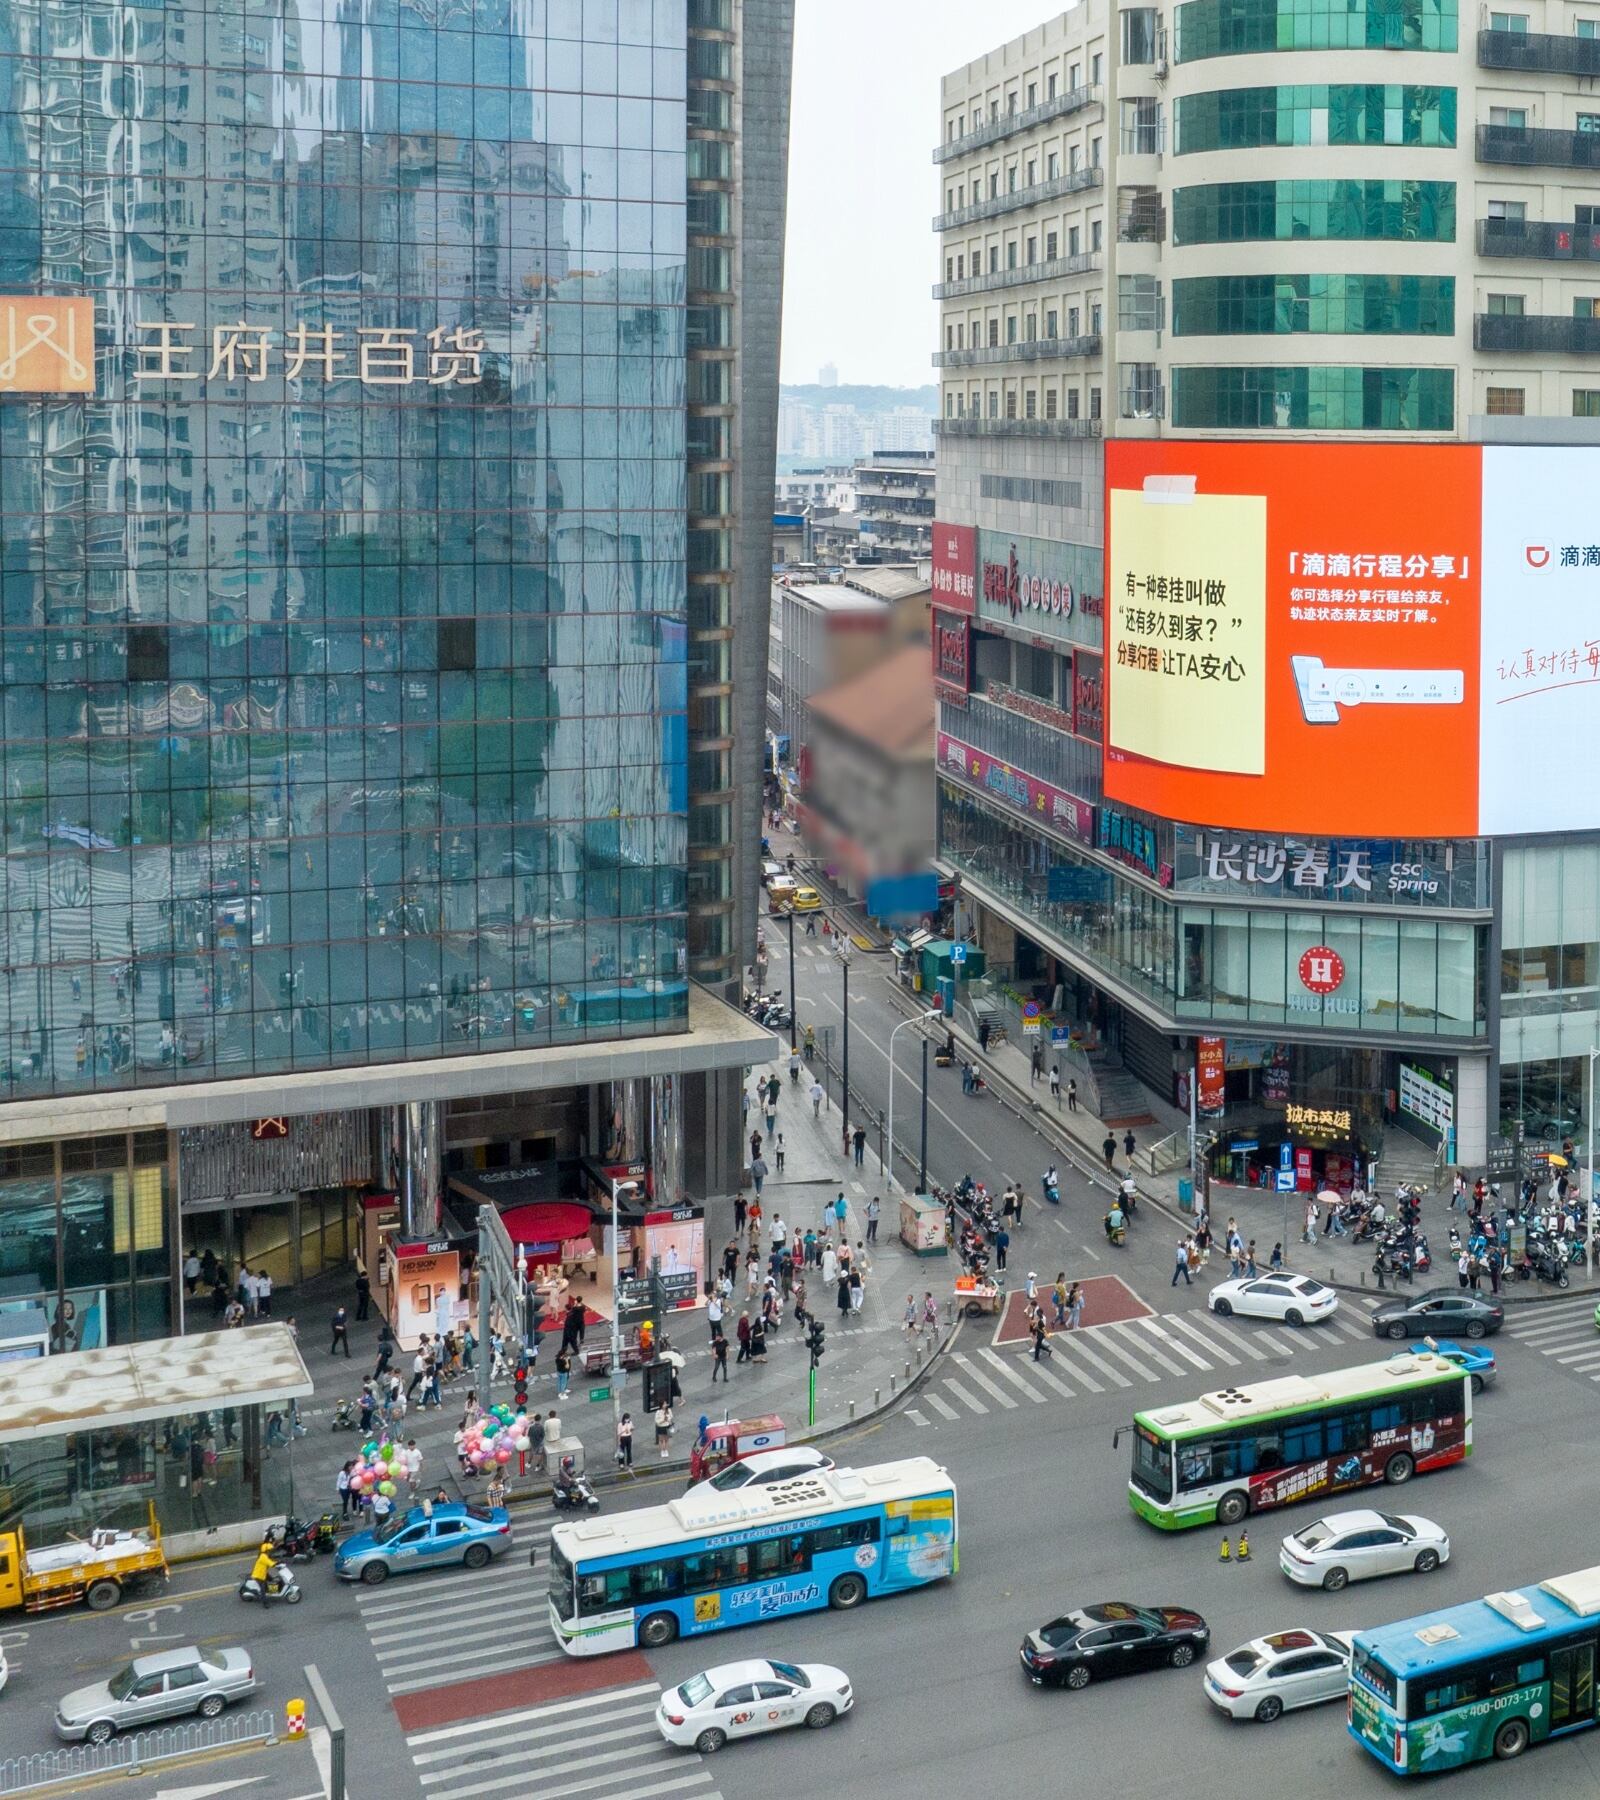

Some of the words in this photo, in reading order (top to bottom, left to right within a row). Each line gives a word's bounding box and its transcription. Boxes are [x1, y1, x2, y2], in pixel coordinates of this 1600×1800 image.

[133, 321, 484, 386] 王府井百货
[1289, 552, 1469, 579] 「滴滴行程分享」
[1126, 571, 1226, 607] 有一种牵挂叫做
[1117, 640, 1159, 674] 分享行程
[1162, 648, 1246, 683] 让TA安心
[1206, 841, 1372, 892] 长沙春天
[1390, 862, 1422, 877] CSC
[1388, 876, 1439, 895] Spring
[1309, 957, 1333, 983] H
[1286, 1103, 1351, 1131] 城市英雄
[1469, 1686, 1543, 1717] 400-0073-177
